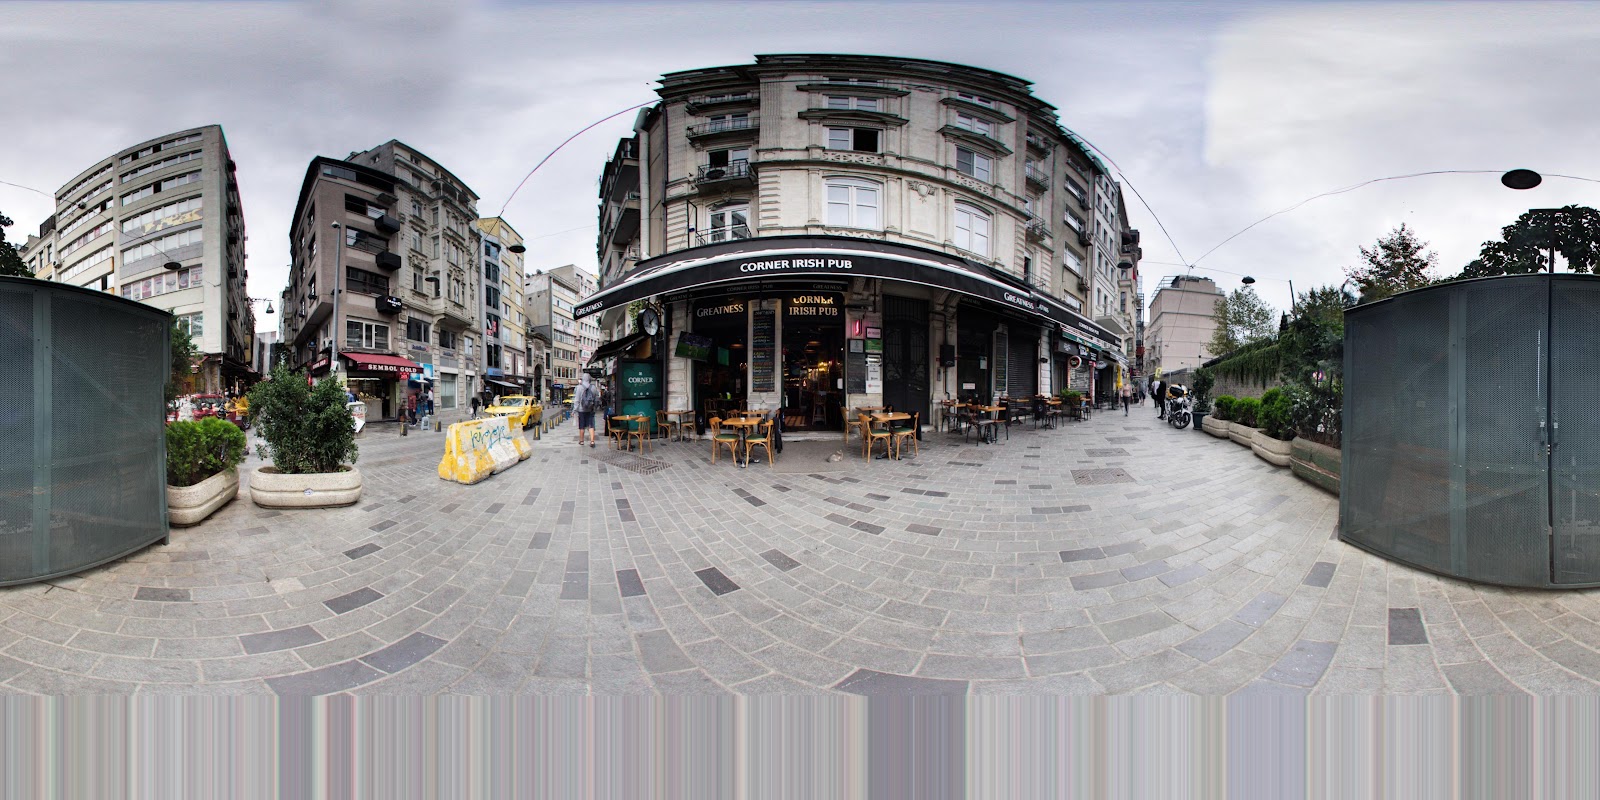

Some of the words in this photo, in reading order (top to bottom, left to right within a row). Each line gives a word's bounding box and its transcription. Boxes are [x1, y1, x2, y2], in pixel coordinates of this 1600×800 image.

[740, 260, 790, 272] CORNER
[792, 259, 824, 269] IRISH
[828, 259, 852, 269] PUB
[812, 283, 842, 291] GREATNESS
[793, 295, 833, 304] CORNER
[1004, 292, 1034, 310] GREATNESS
[575, 300, 604, 316] GREATNESS
[696, 303, 744, 317] GREATNESS
[789, 306, 817, 315] IRISH
[818, 307, 838, 316] PUB
[367, 363, 398, 372] SEMBOL
